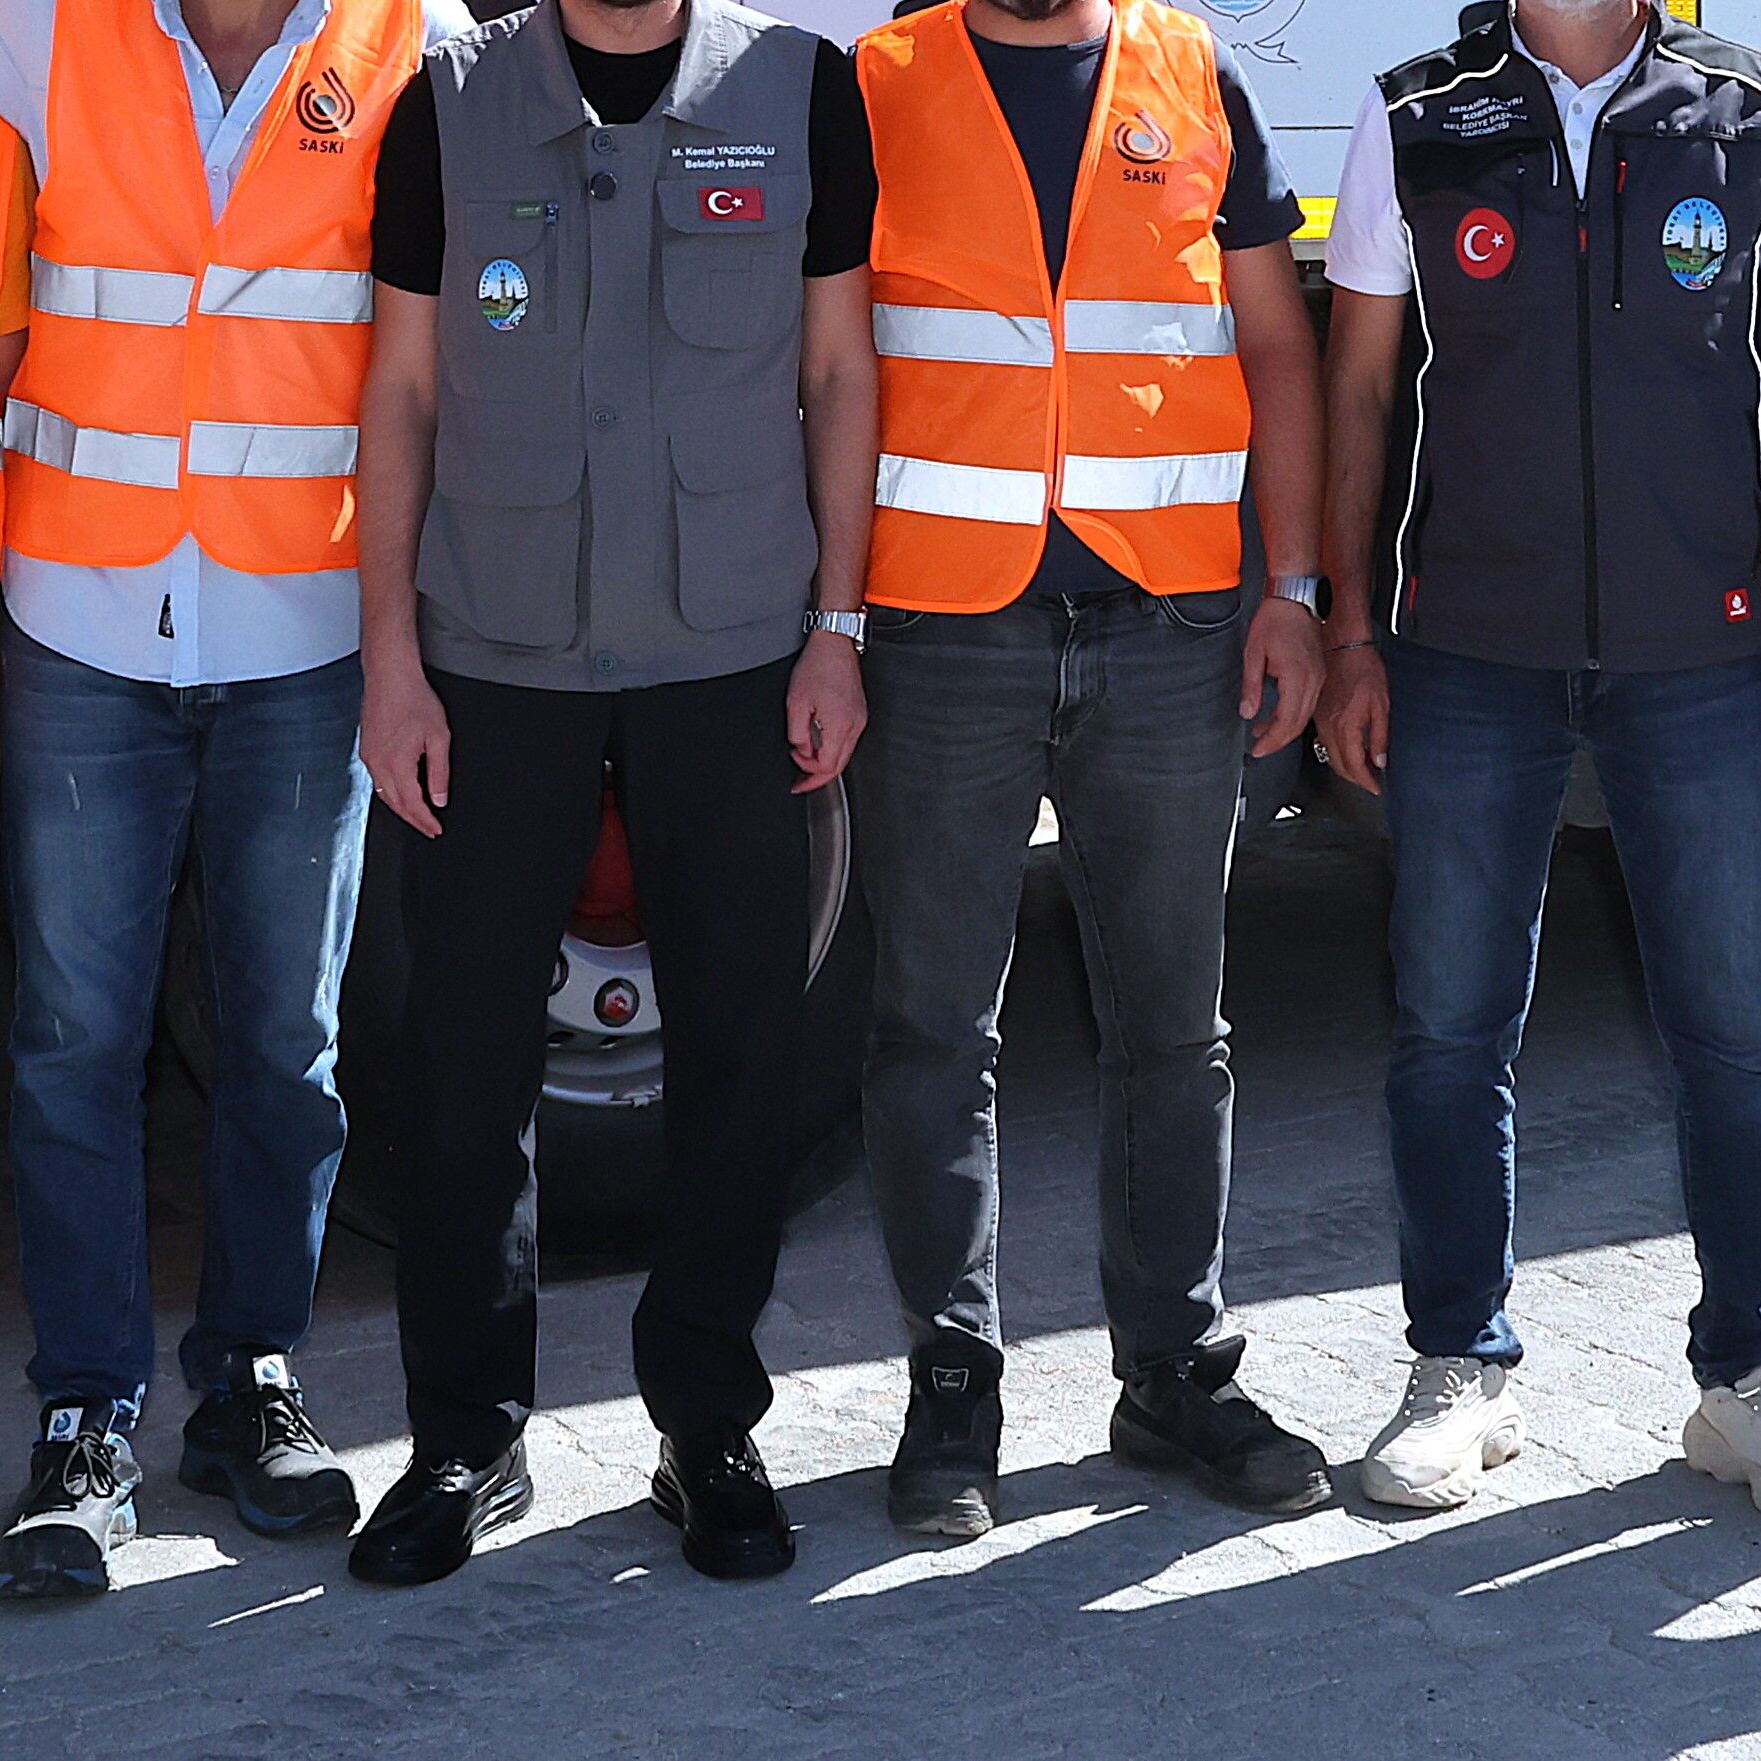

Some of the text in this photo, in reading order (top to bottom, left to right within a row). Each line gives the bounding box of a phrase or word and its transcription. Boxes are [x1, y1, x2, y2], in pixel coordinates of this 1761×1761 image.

[671, 143, 775, 157] M. Kemal YAZICIOĞLU
[684, 158, 765, 170] Belediye Başkanı
